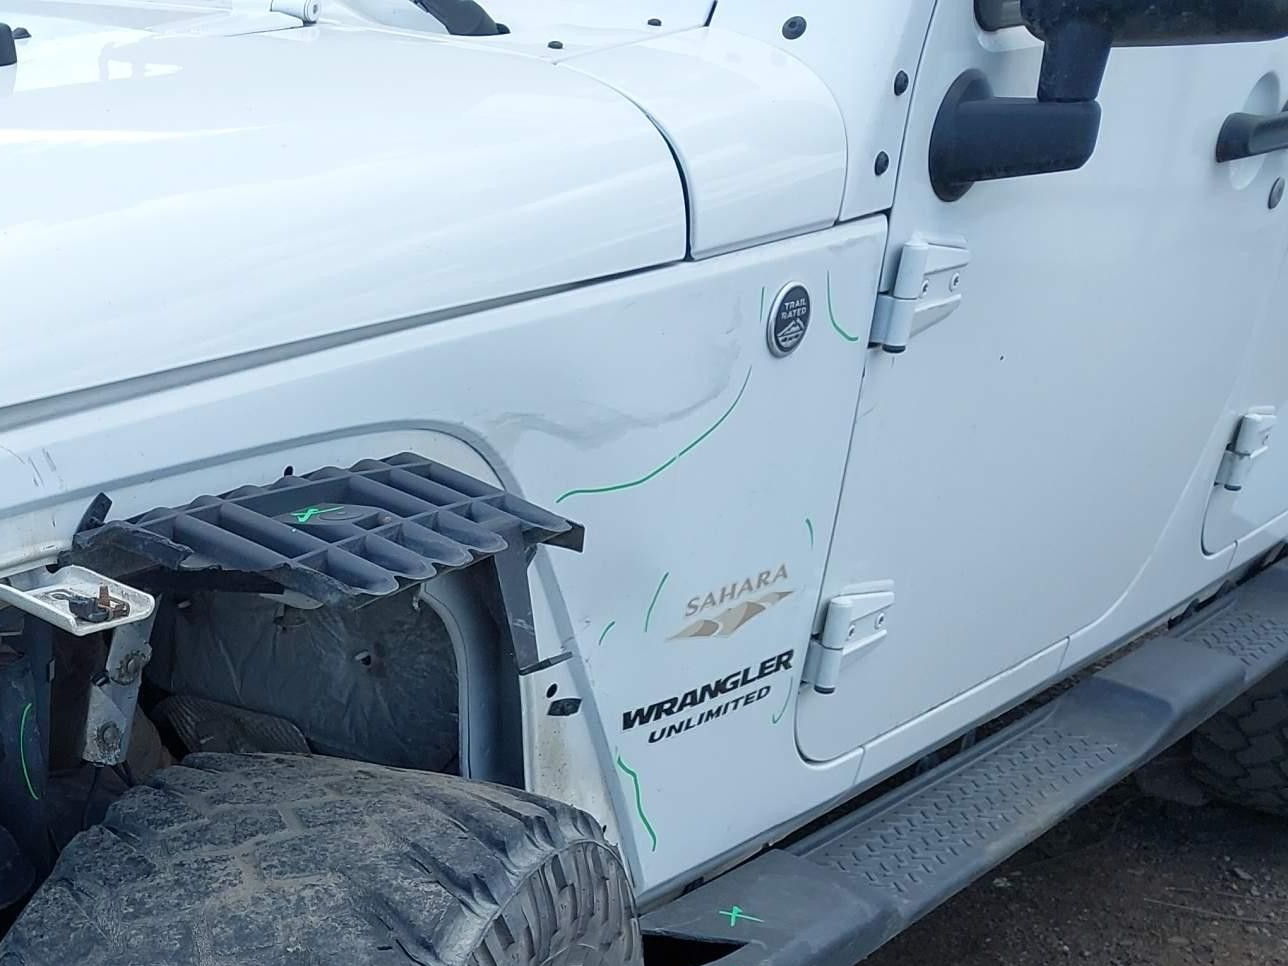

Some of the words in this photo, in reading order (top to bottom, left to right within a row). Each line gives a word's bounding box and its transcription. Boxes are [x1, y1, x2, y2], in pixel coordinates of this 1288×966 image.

[781, 307, 806, 319] RATED
[784, 299, 806, 310] TRAIL
[685, 564, 788, 617] SAHARA
[622, 649, 794, 731] WRANGLER
[648, 685, 771, 744] UNLIMITED
